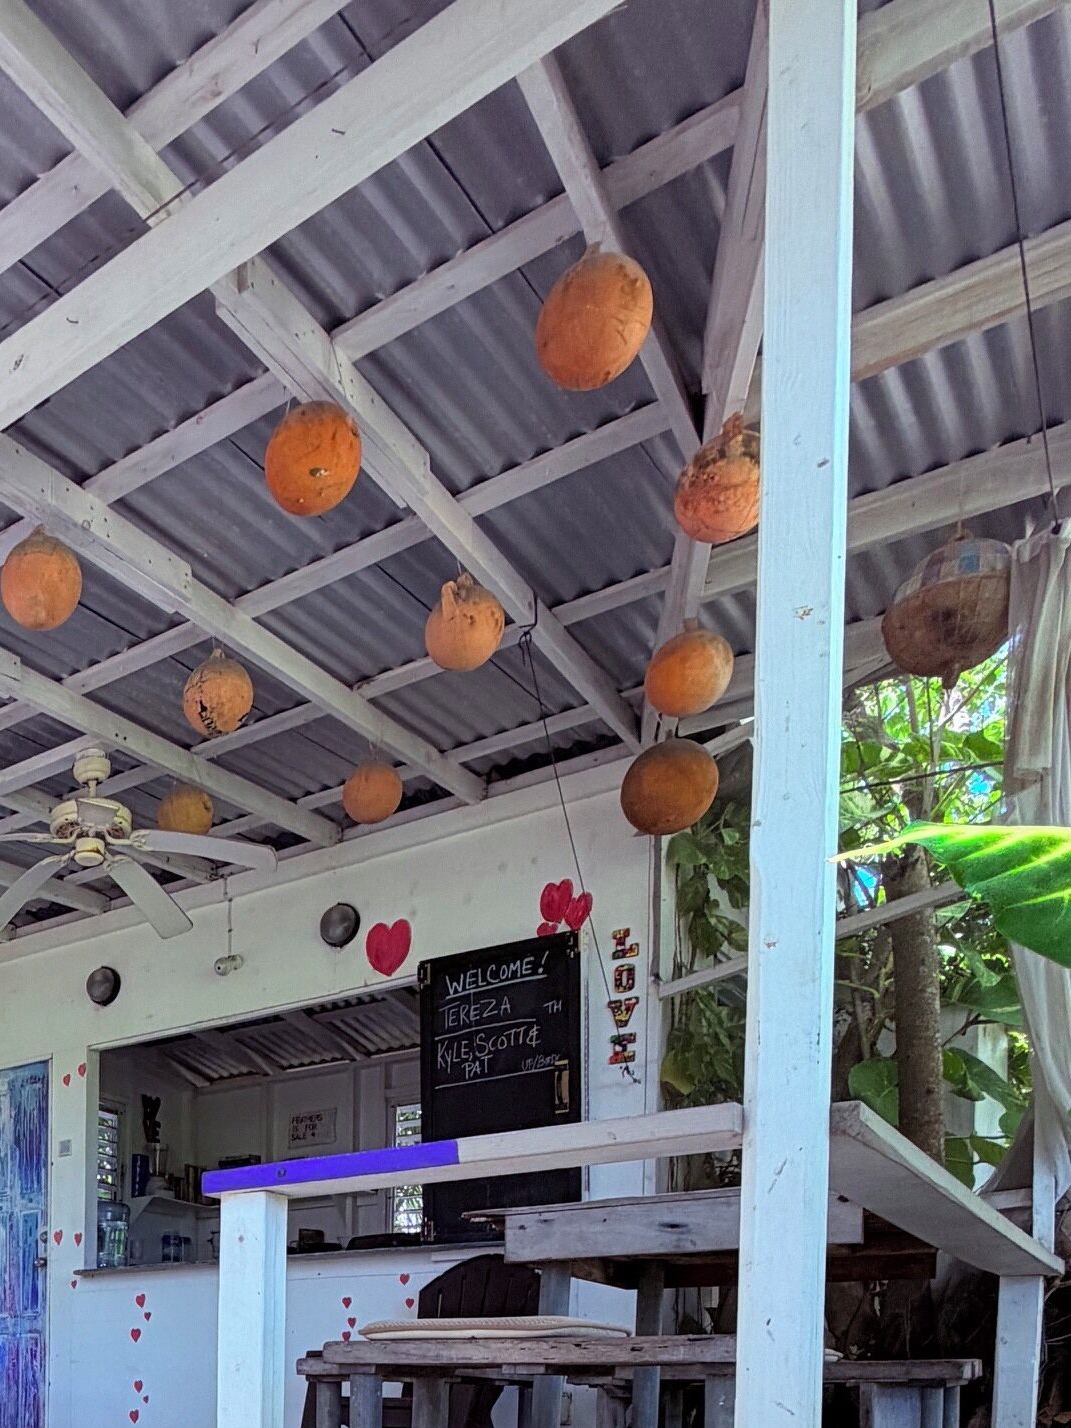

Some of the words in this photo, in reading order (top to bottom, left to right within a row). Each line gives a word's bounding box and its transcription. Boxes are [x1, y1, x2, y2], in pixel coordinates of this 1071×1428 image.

[446, 951, 548, 994] WELCOME!
[439, 996, 511, 1030] TEREZA
[543, 1000, 562, 1013] TH
[607, 928, 640, 1065] LOVE
[475, 1026, 527, 1057] SCOTT
[462, 1054, 493, 1079] PAT
